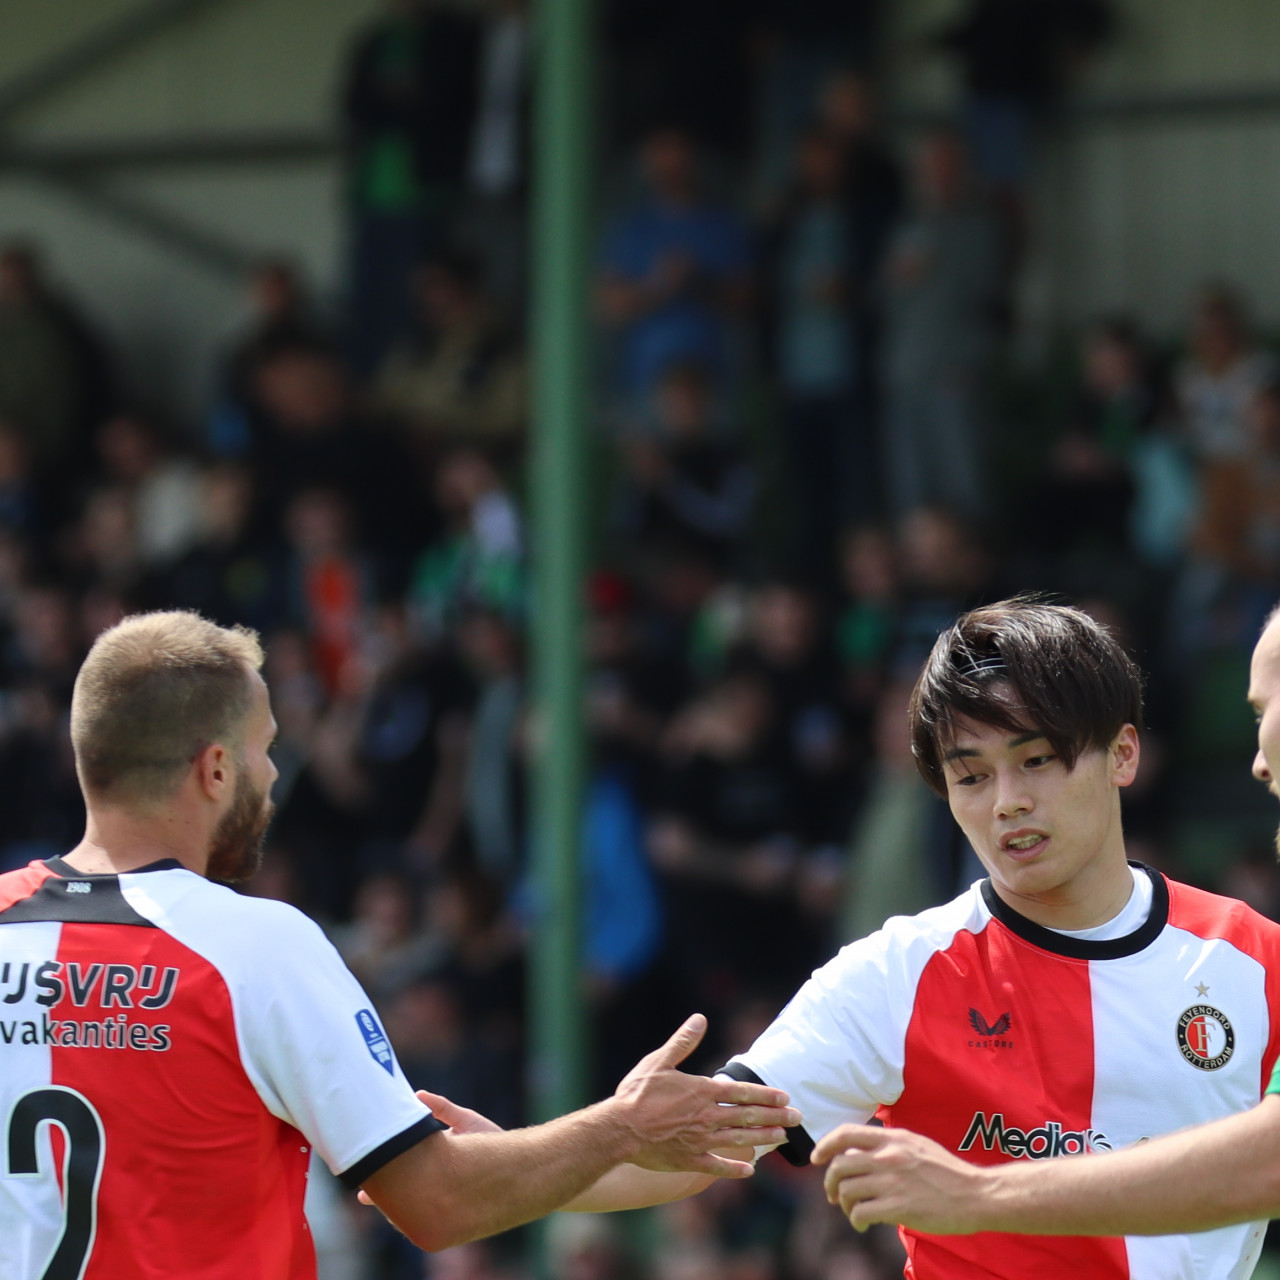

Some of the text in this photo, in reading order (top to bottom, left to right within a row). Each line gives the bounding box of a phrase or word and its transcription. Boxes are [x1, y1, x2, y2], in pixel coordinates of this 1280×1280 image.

[1179, 1006, 1231, 1031] FEYENOORD
[0, 1013, 172, 1052] vakanties
[967, 1039, 1015, 1049] CASTORE
[1180, 1044, 1233, 1069] ROTTERDAM
[957, 1111, 1086, 1160] Media
